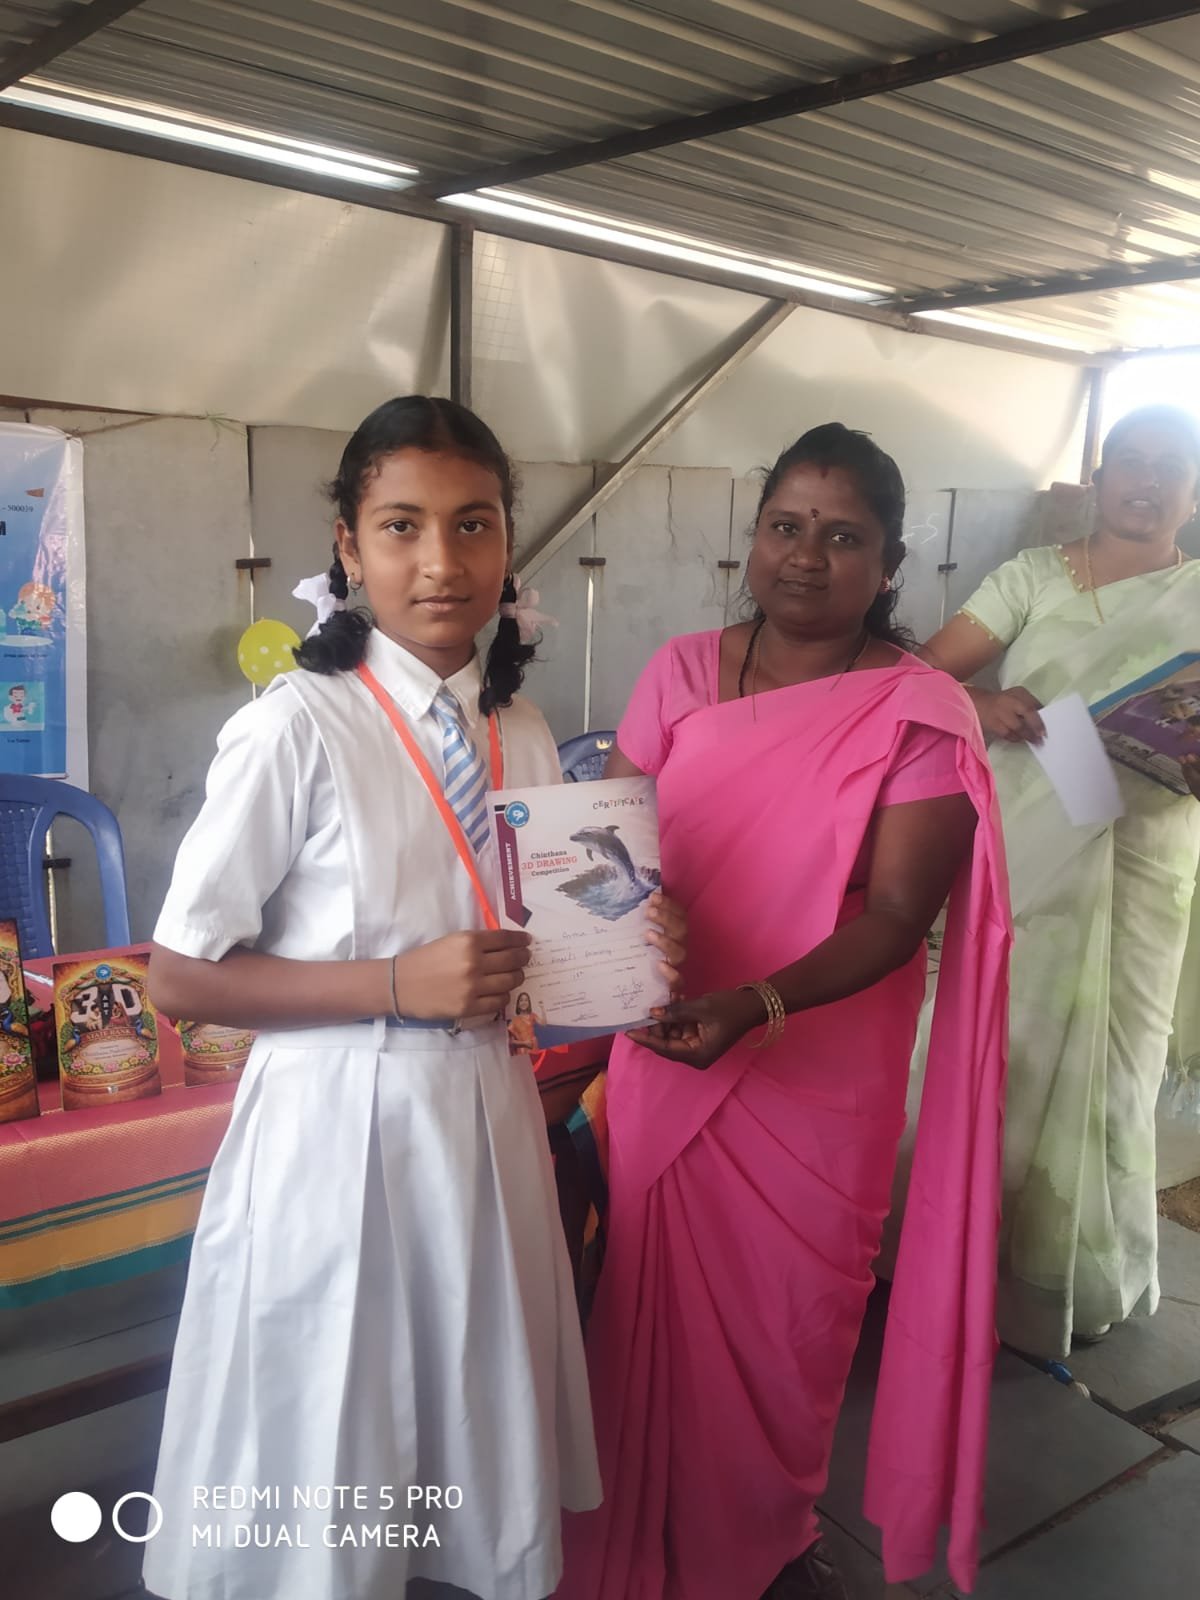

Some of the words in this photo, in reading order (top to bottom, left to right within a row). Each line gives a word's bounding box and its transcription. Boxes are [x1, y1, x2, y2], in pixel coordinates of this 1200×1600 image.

[592, 797, 645, 810] CERTIFICATE
[521, 861, 534, 870] 3D
[536, 856, 578, 868] DRAWING
[505, 842, 516, 900] ACHIEVEMENT
